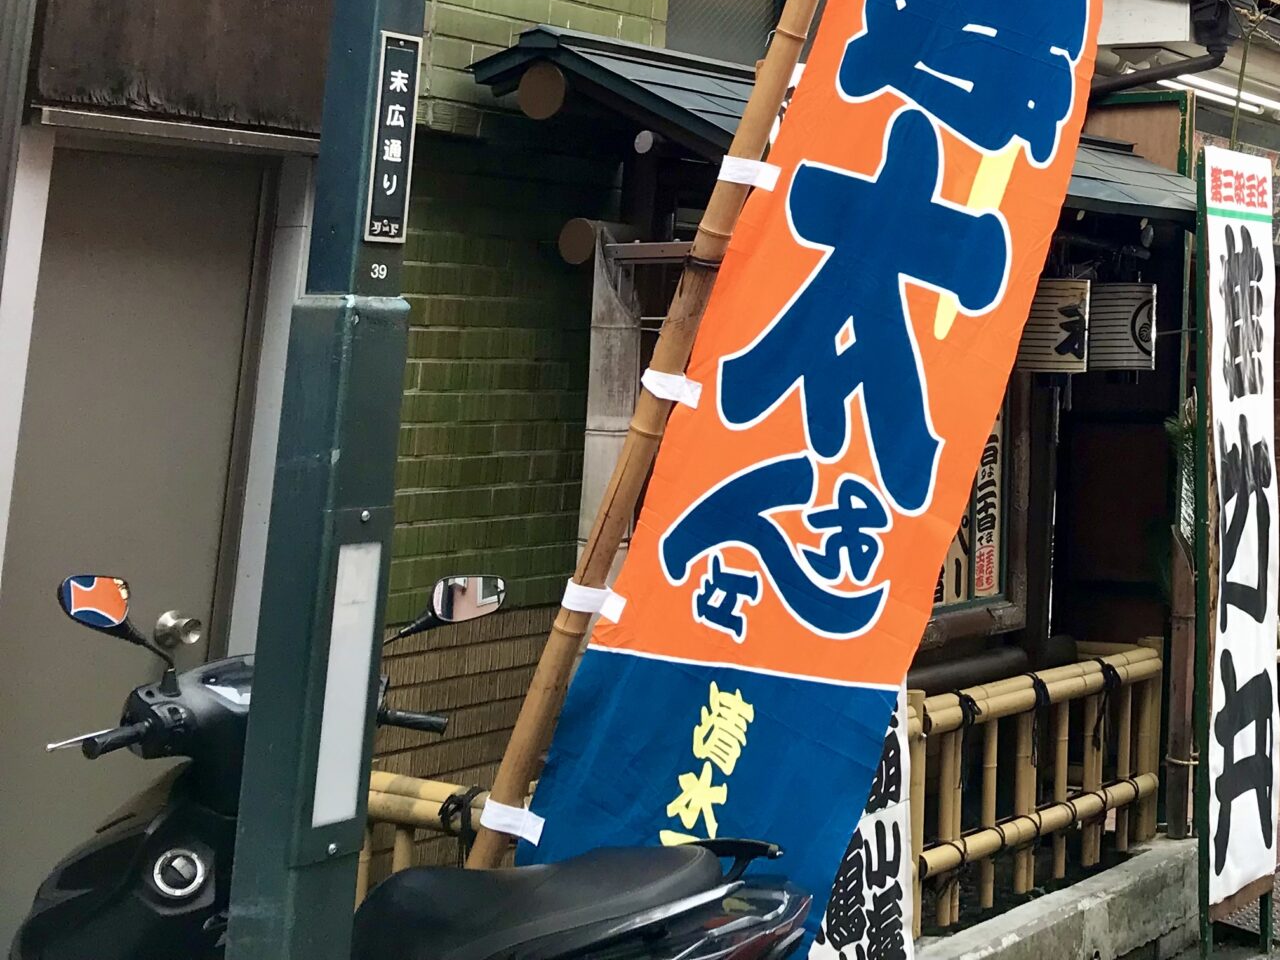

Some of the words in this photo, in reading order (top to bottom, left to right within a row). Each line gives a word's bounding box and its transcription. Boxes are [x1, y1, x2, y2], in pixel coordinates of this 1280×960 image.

[382, 69, 410, 196] 末広通り
[370, 263, 388, 280] 39
[659, 681, 755, 846] 清水
